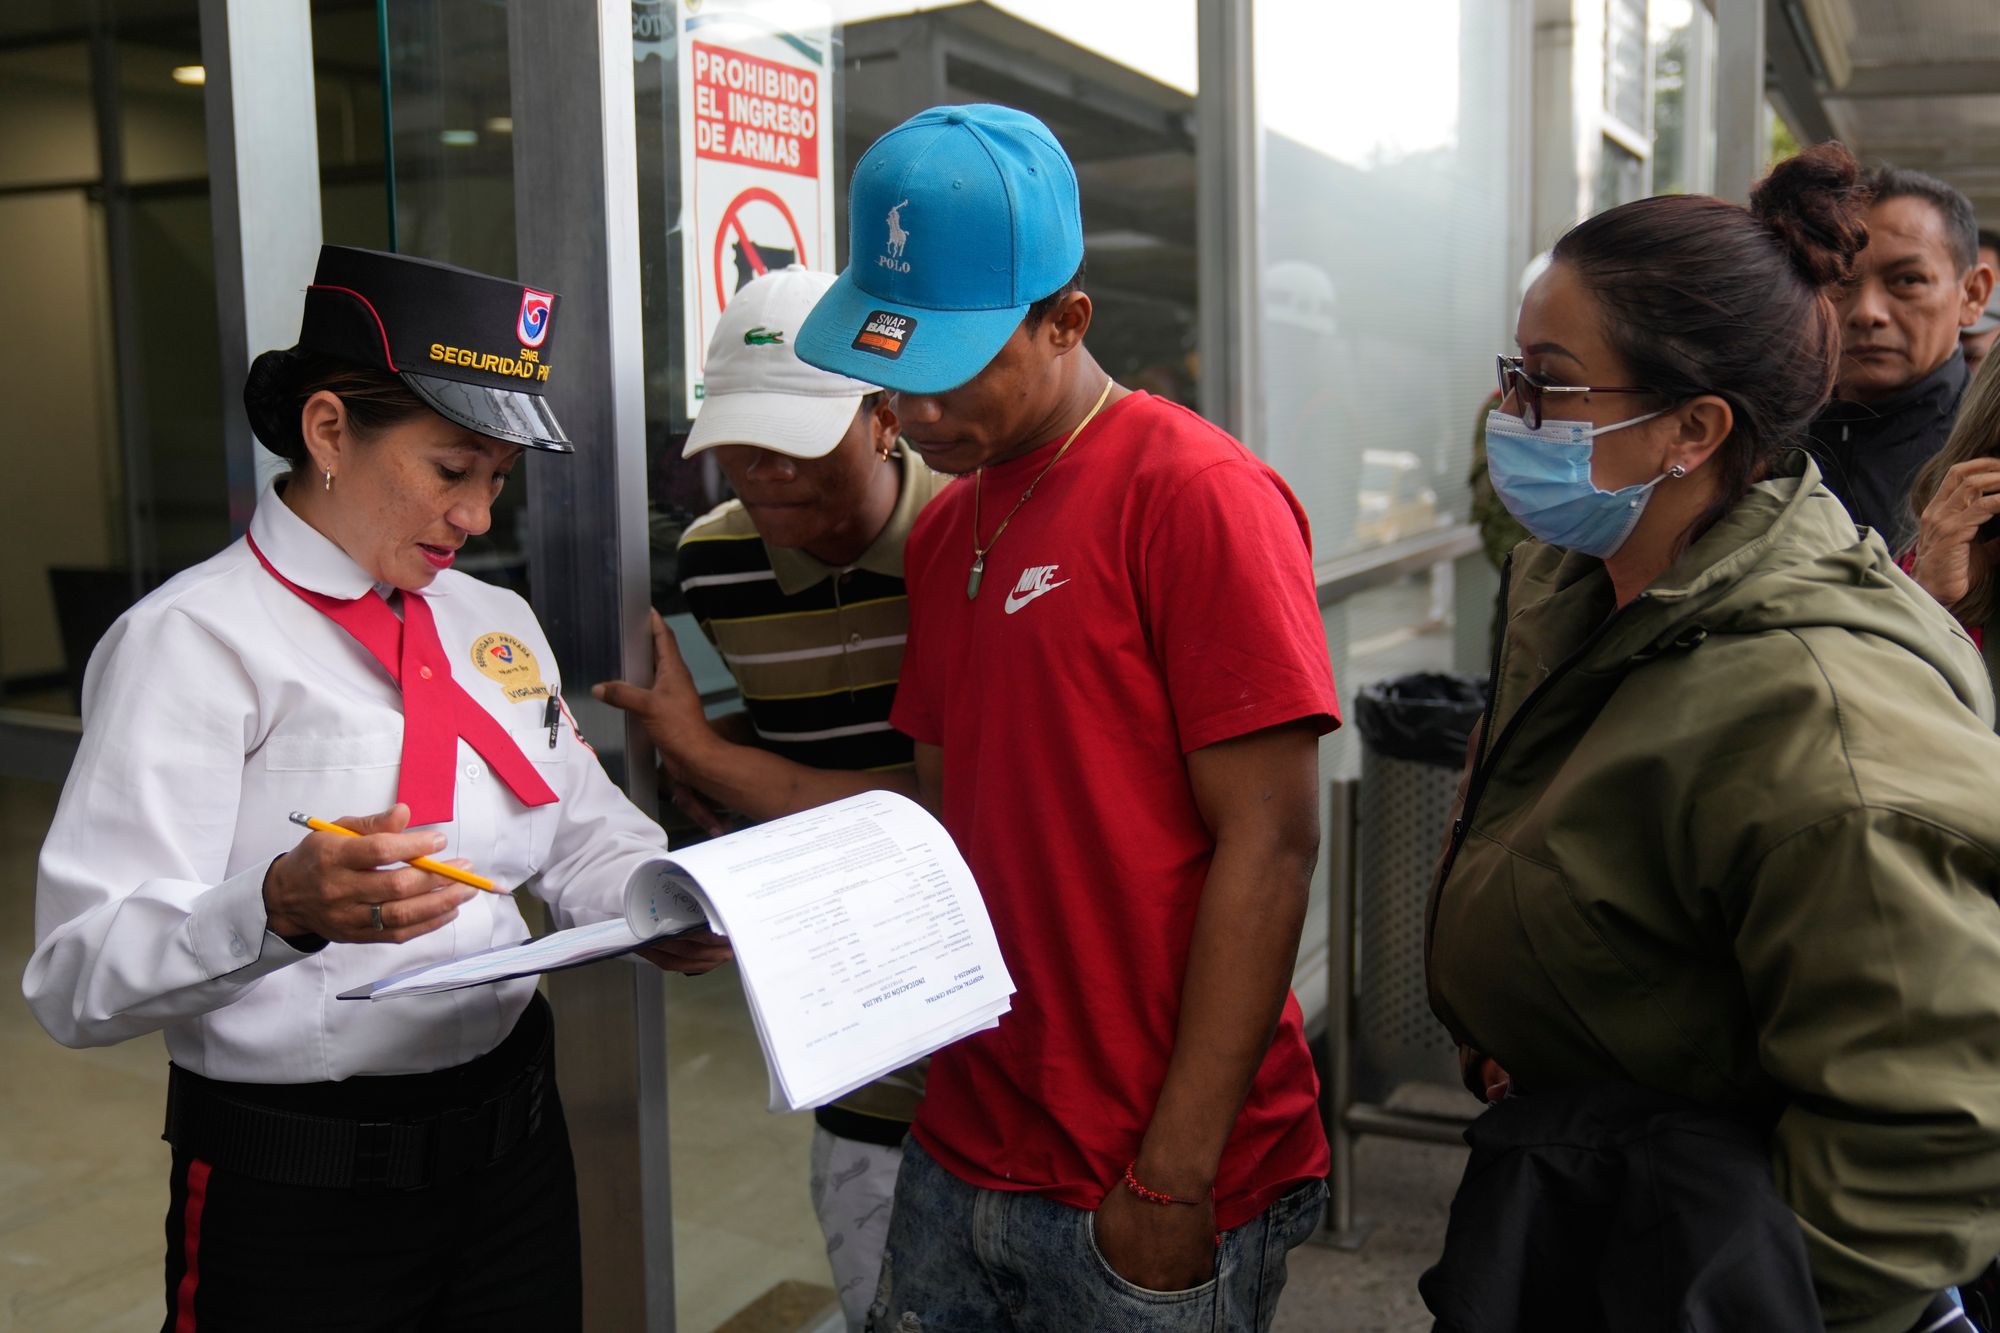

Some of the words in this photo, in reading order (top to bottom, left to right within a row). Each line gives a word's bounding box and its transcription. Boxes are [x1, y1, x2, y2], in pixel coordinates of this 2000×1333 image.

[695, 49, 816, 107] PROHIBIDO
[696, 84, 724, 120] EL
[728, 91, 816, 139] INGRESO
[697, 119, 727, 154] DE
[730, 126, 801, 168] ARMAS
[879, 255, 911, 274] POLO
[865, 322, 907, 341] BACK
[877, 313, 907, 328] SNAP
[429, 343, 534, 379] SEGURIDAD
[1013, 564, 1060, 594] NIKE
